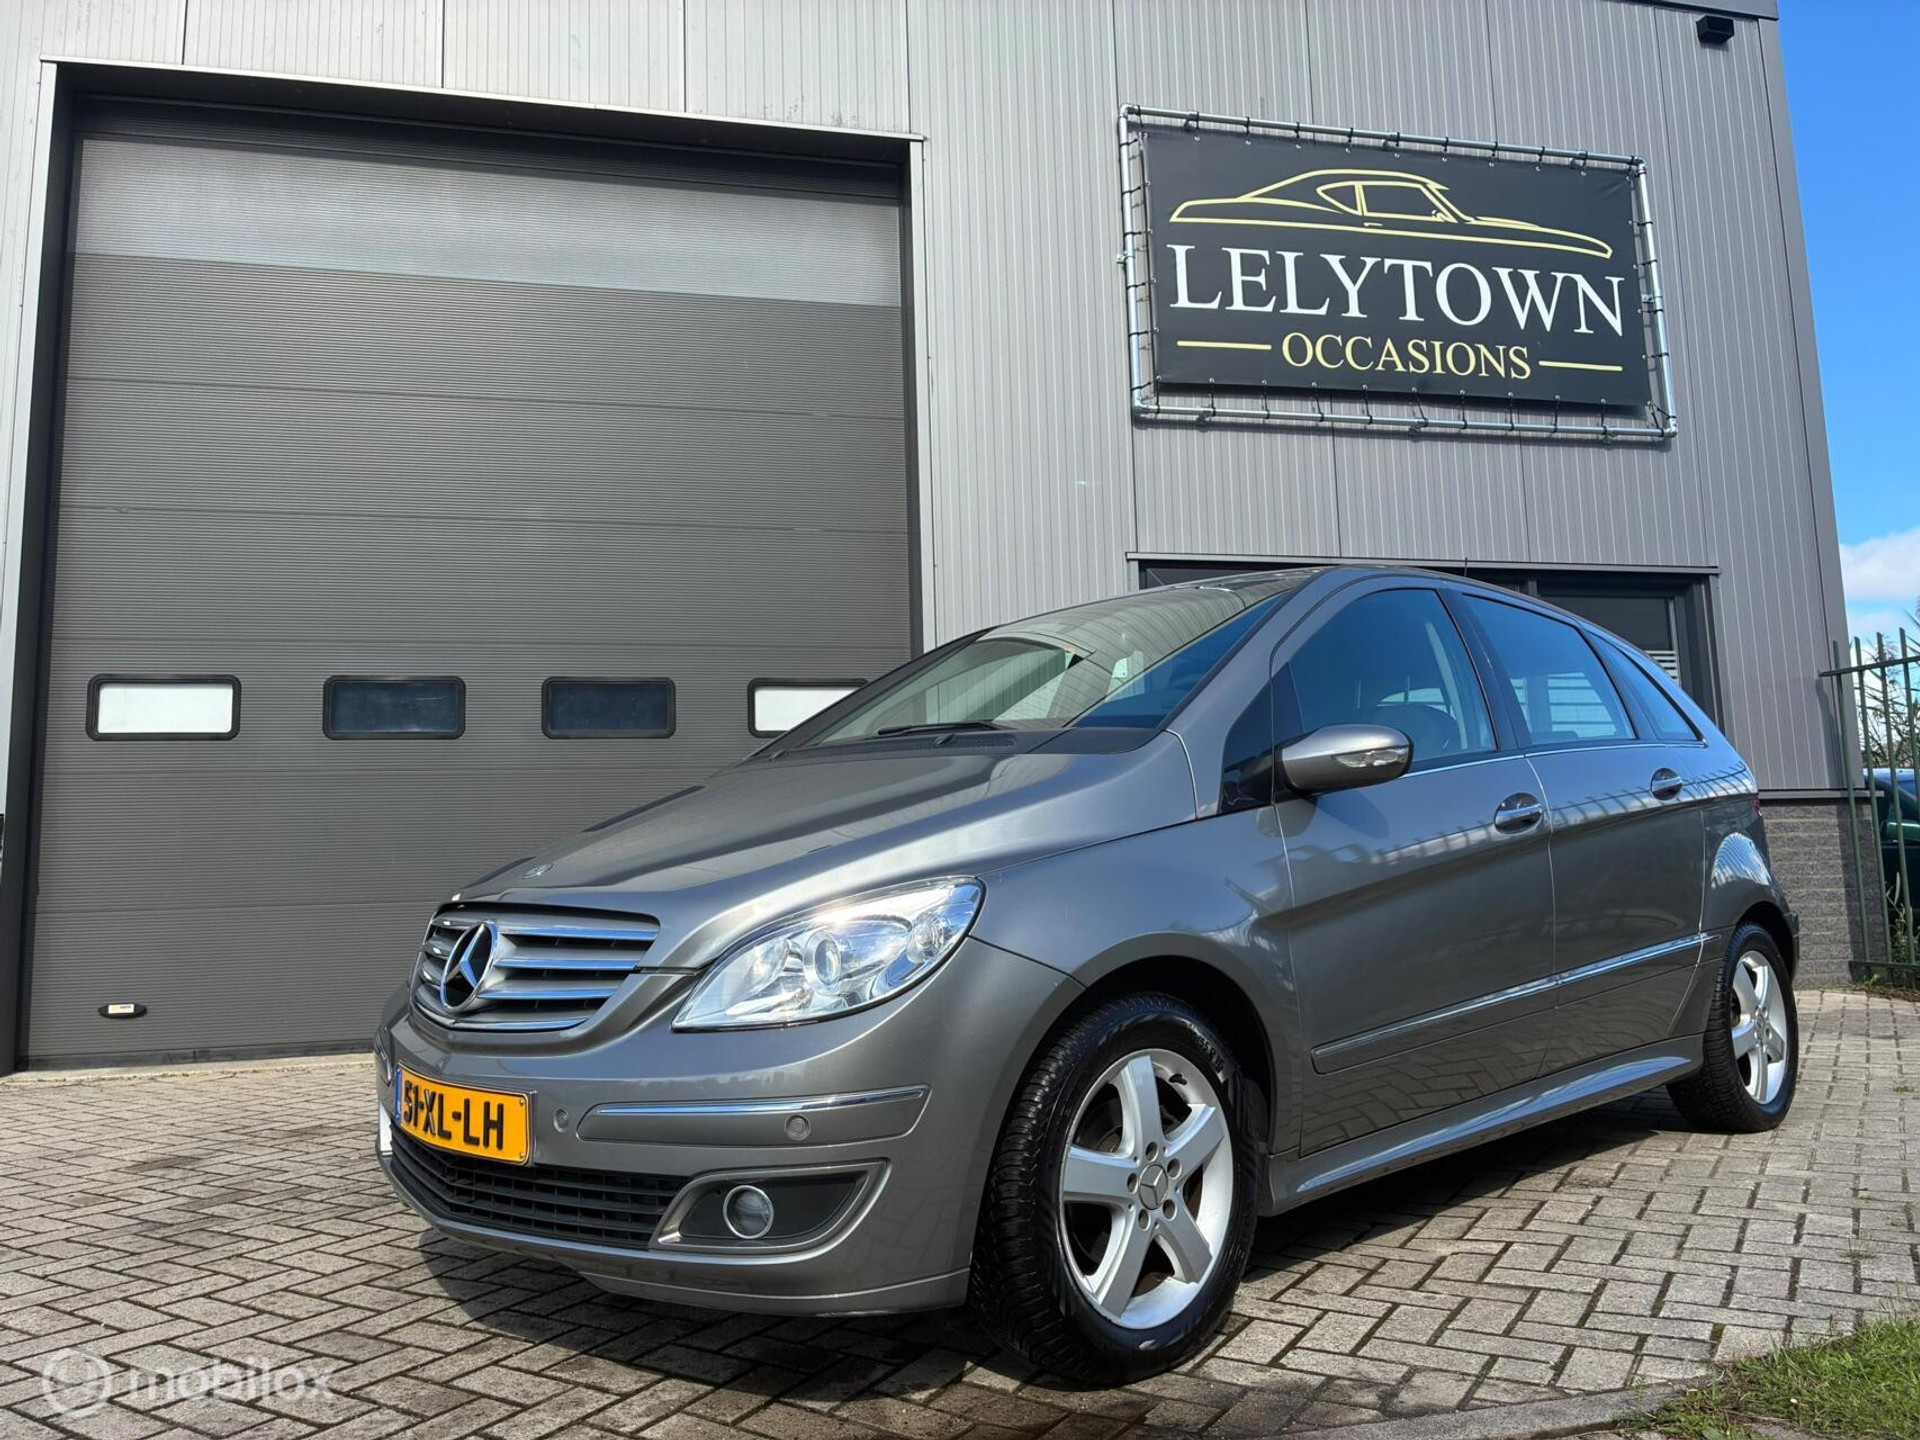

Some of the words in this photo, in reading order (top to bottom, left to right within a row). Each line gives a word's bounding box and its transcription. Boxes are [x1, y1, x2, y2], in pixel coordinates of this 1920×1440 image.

[1166, 244, 1625, 337] LELYTOWN
[1282, 332, 1531, 379] OCCASIONS
[403, 1080, 504, 1150] 51-XL-LH
